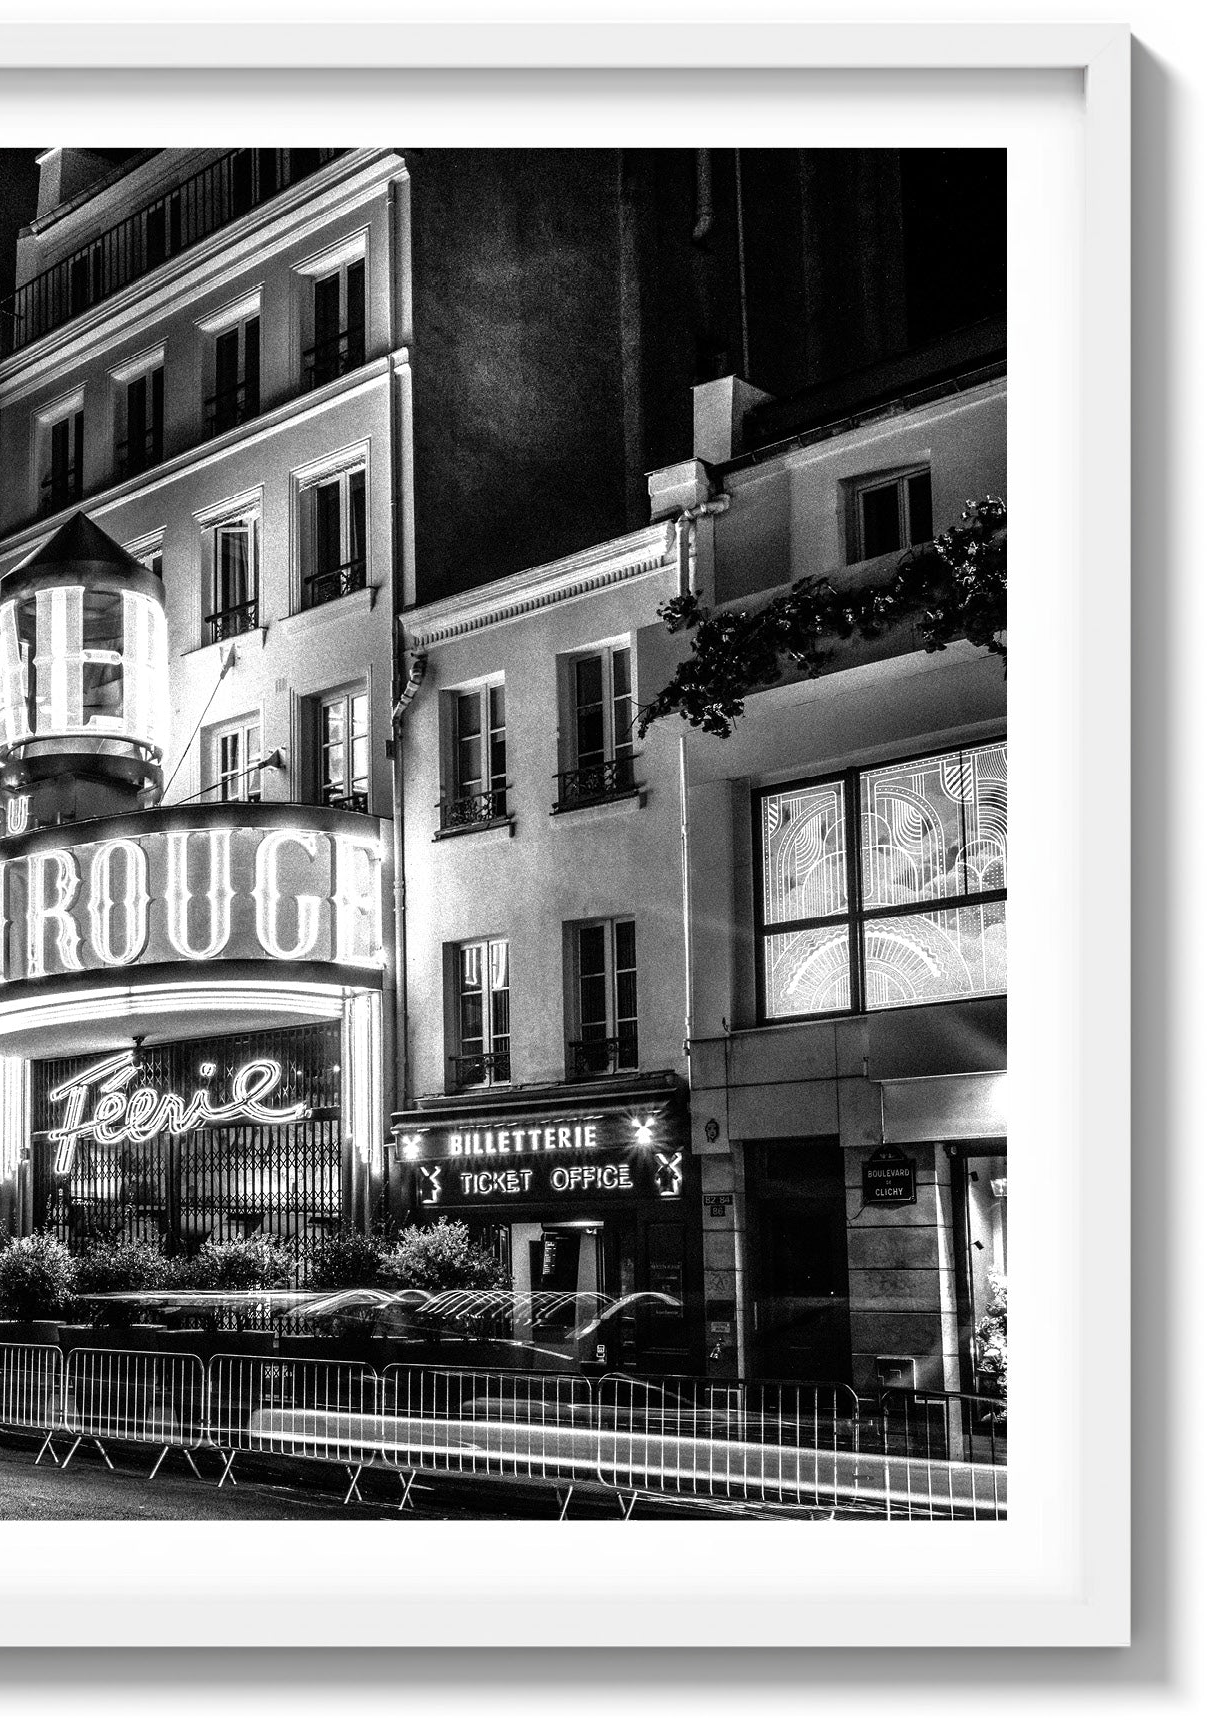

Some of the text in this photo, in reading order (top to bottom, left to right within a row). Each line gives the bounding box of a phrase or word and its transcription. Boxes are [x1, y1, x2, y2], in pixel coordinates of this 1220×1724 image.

[26, 827, 385, 977] ROUGE
[450, 1125, 597, 1155] BILLETTERIE
[460, 1165, 634, 1195] TICKET OFFICE
[867, 1169, 910, 1178] BOULEVARD
[875, 1187, 904, 1197] CLICHY
